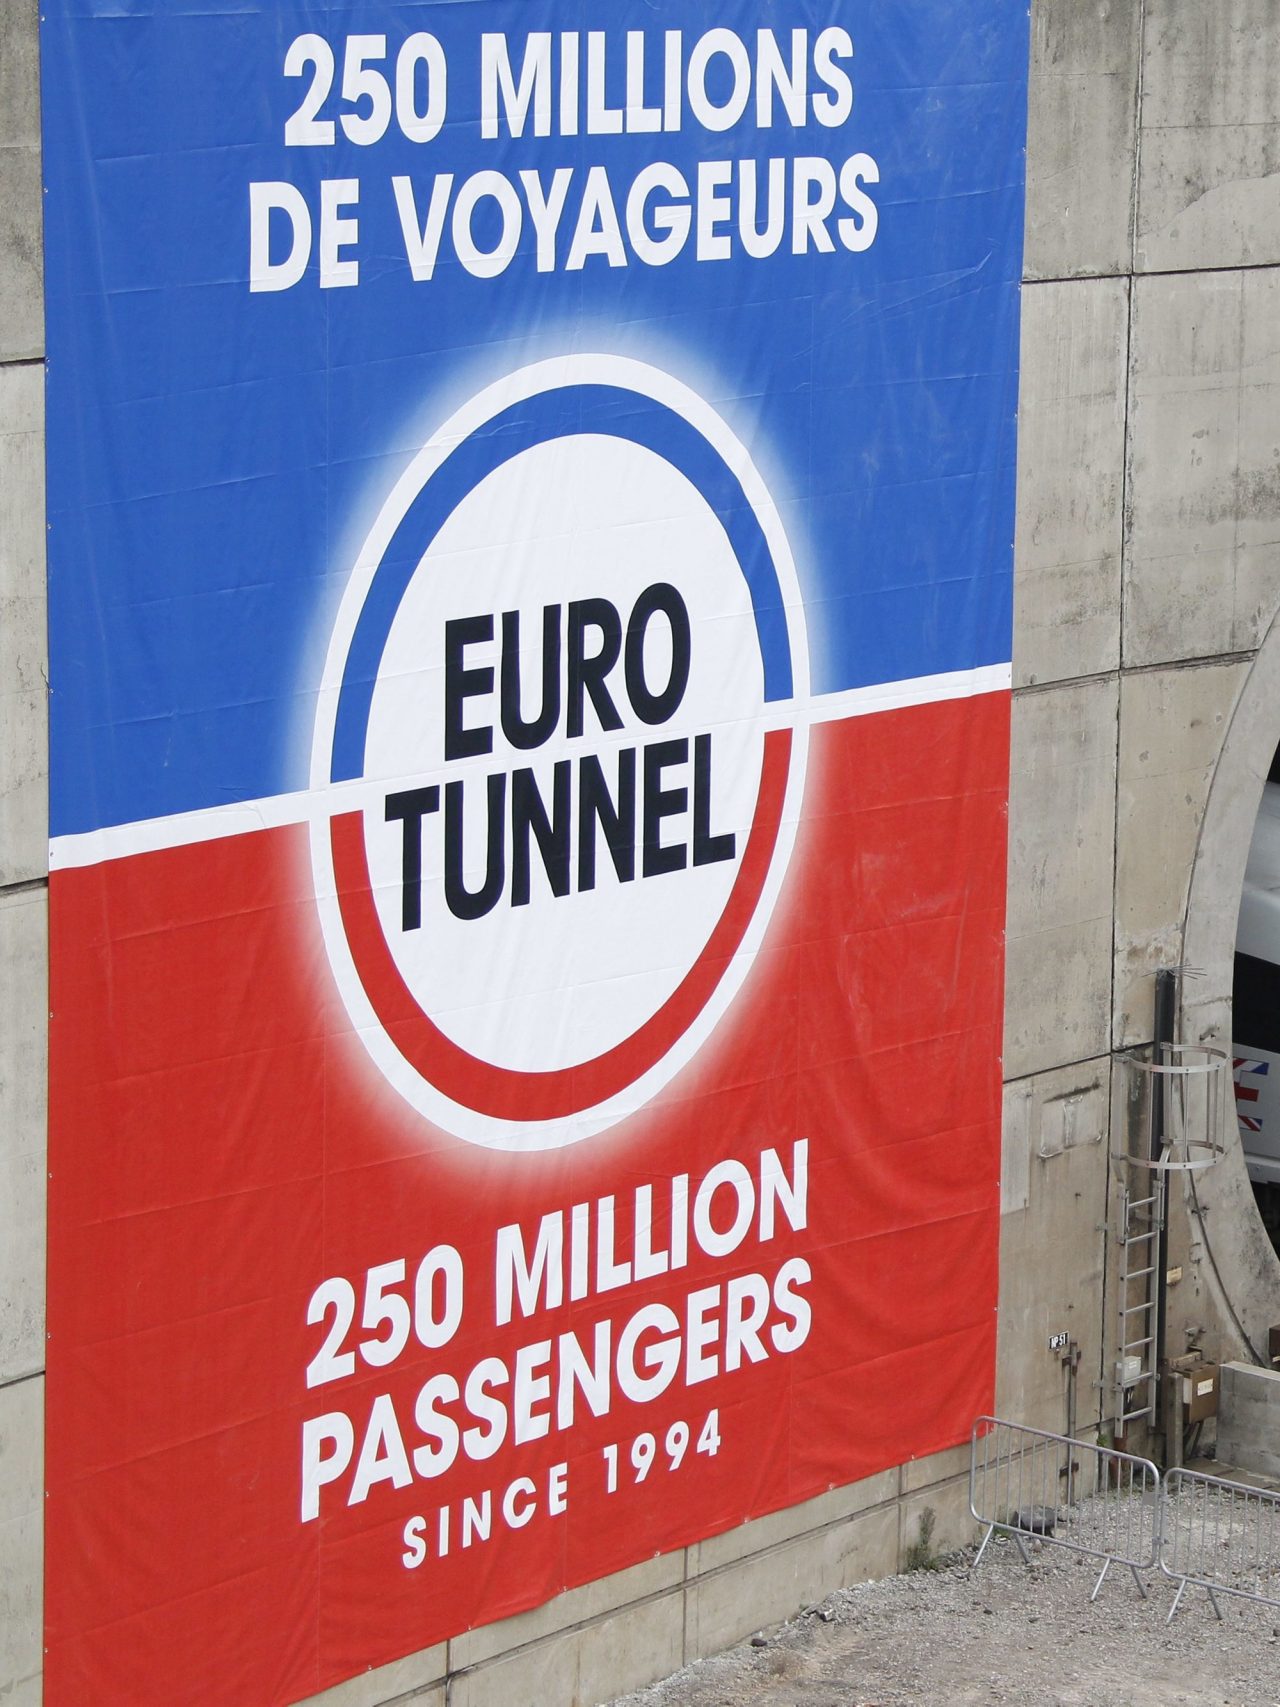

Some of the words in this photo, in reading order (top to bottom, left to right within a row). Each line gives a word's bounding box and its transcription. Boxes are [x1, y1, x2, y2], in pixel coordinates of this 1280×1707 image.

[283, 32, 447, 147] 250
[480, 26, 854, 139] MILLIONS
[249, 178, 360, 293] DE
[391, 152, 880, 283] VOYAGEURS
[444, 582, 691, 762] EURO
[384, 733, 736, 932] TUNNEL
[306, 1244, 464, 1391] 250
[495, 1137, 809, 1327] MILLION
[300, 1257, 812, 1524] PASSENGERS
[402, 1462, 568, 1569] SINCE
[603, 1408, 722, 1494] 1994
